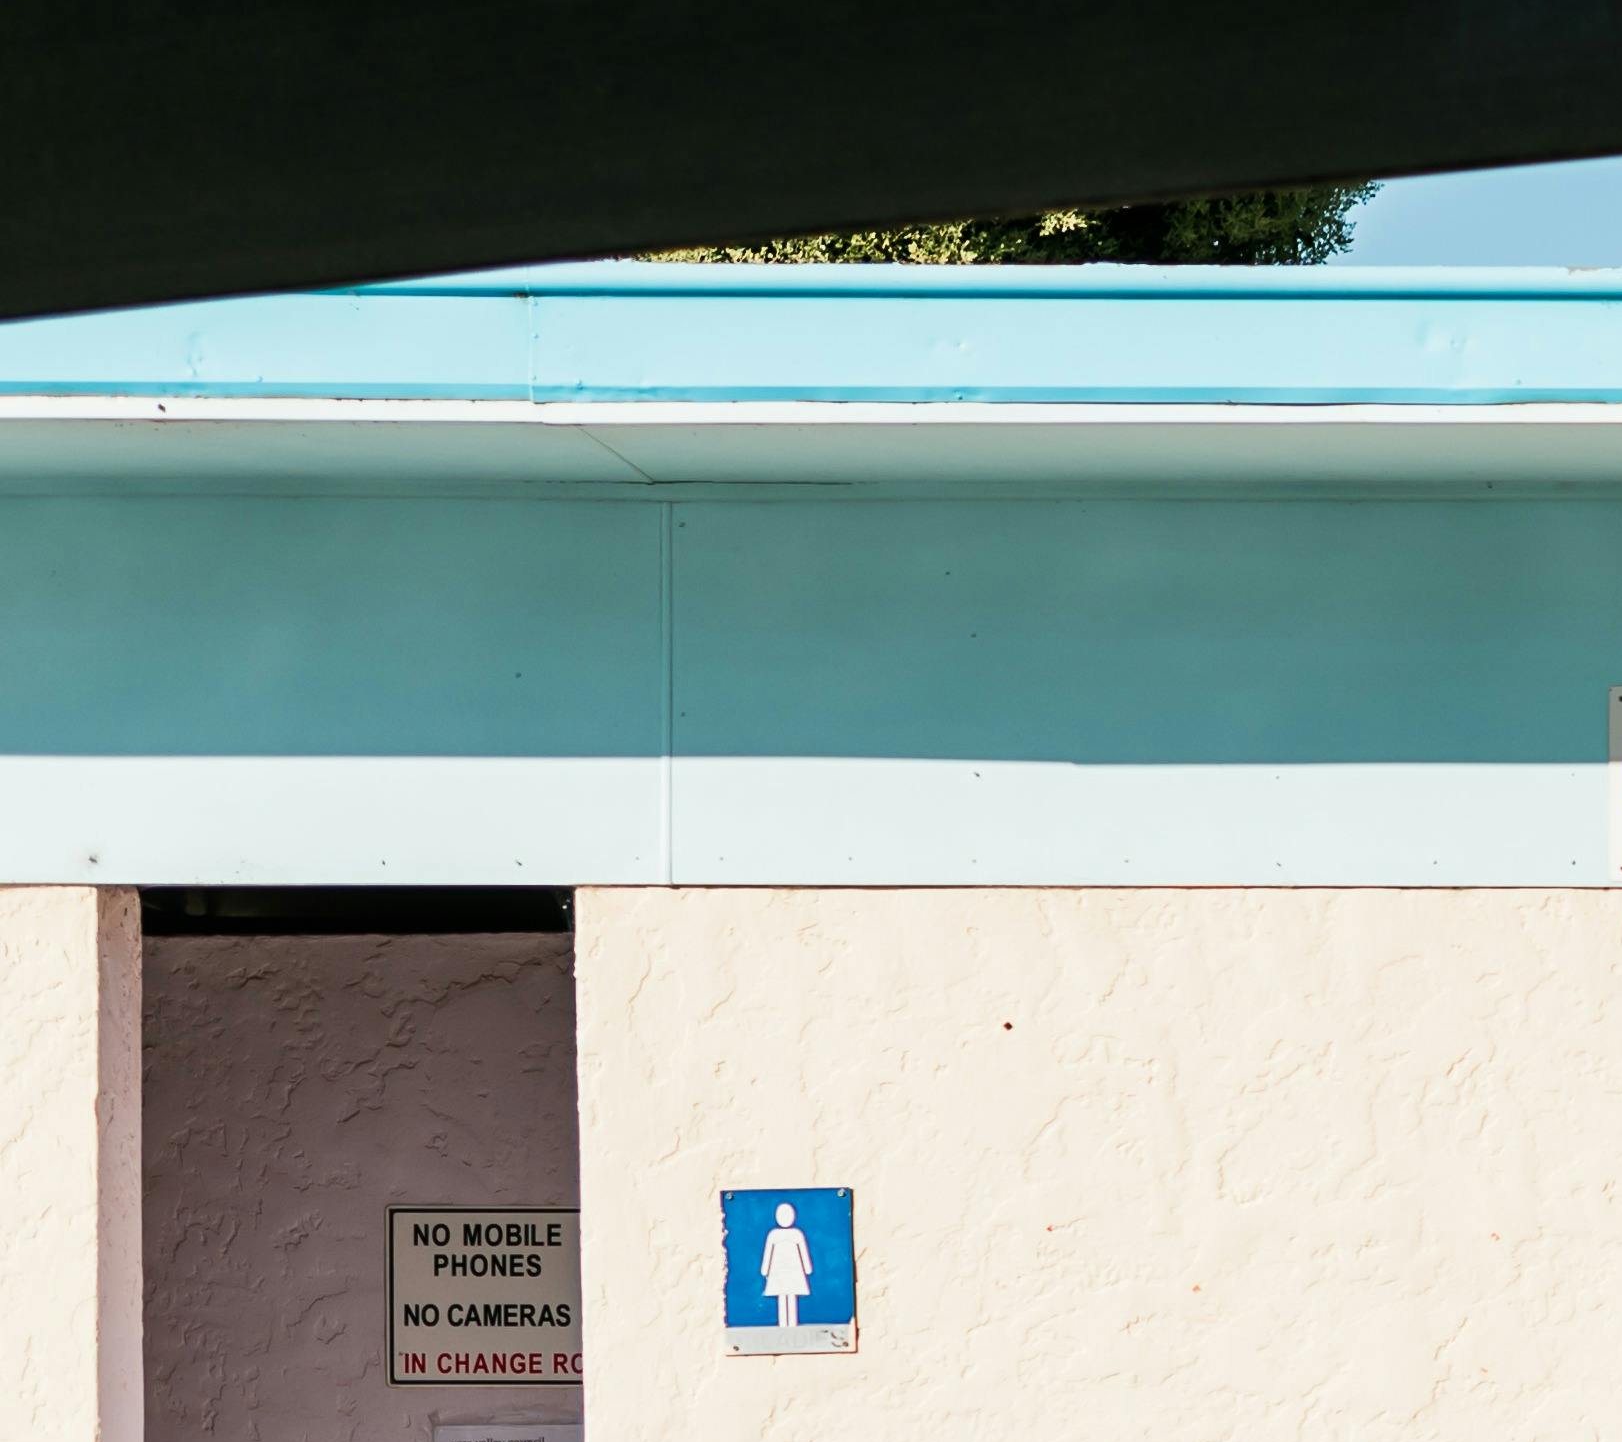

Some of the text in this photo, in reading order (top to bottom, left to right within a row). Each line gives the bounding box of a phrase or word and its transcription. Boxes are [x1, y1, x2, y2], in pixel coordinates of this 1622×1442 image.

[413, 1224, 562, 1247] NO MOBILE
[434, 1254, 542, 1278] PHONES
[403, 1304, 571, 1328] NO CAMERAS
[404, 1353, 426, 1374] IN
[436, 1353, 543, 1374] CHANGE
